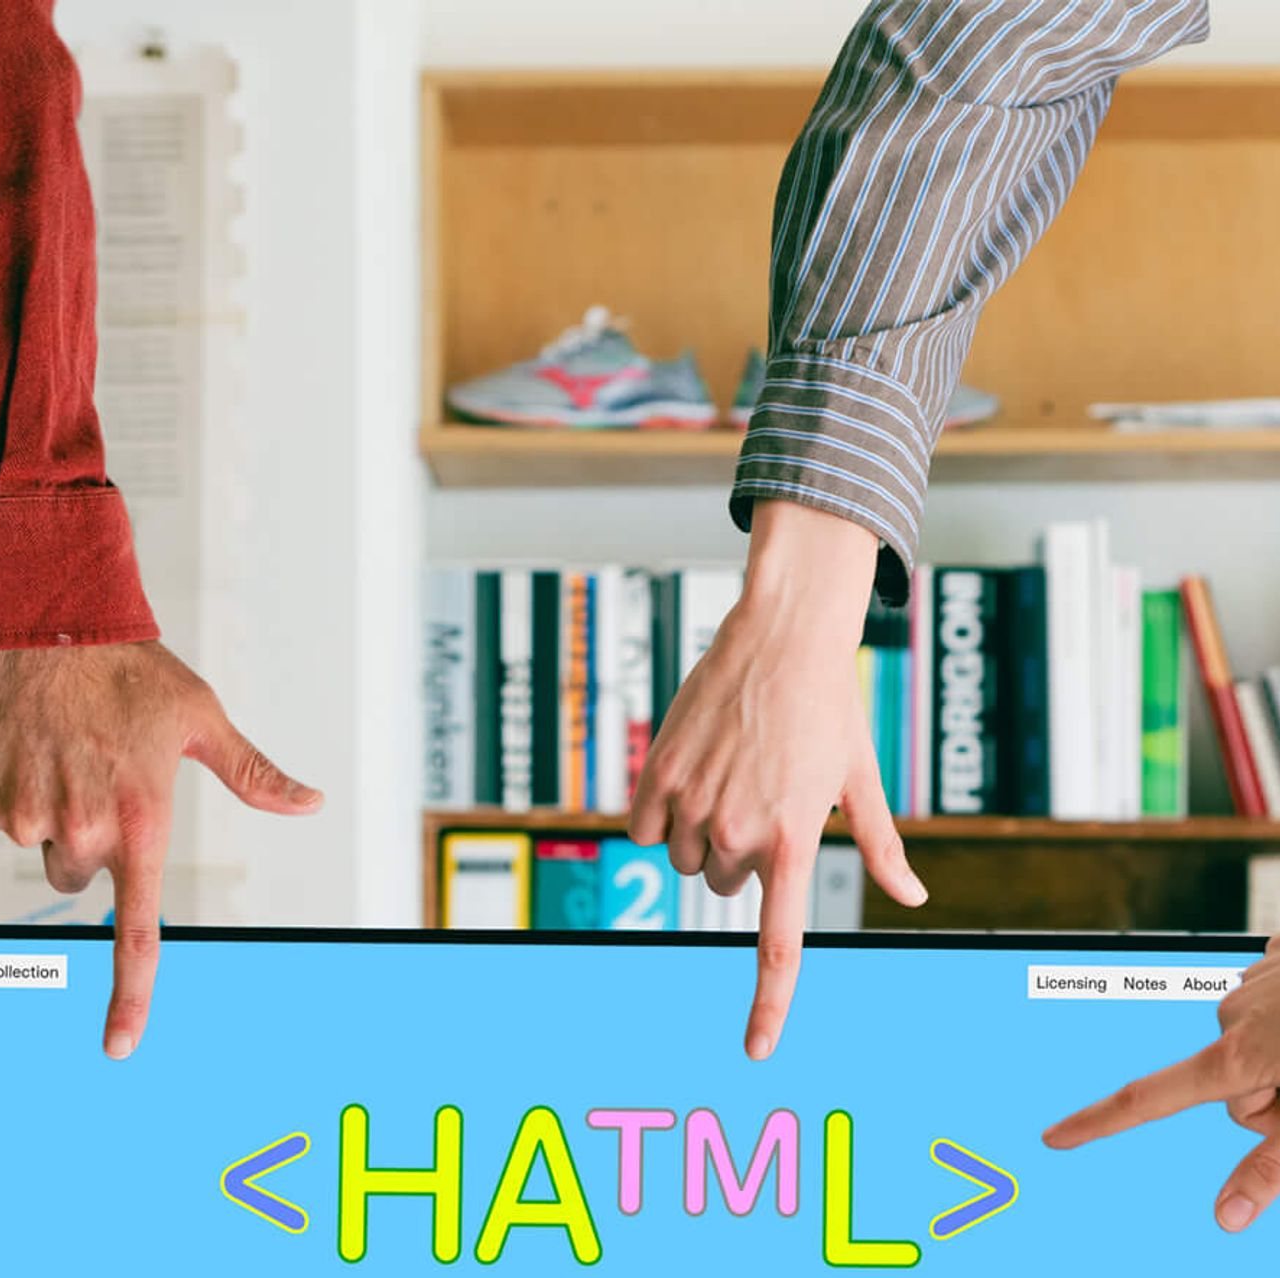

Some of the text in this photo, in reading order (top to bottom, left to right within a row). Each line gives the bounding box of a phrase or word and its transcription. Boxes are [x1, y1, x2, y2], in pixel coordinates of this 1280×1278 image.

[424, 622, 464, 801] Munken
[613, 859, 665, 930] 2
[1036, 975, 1228, 994] Licensing Notes About
